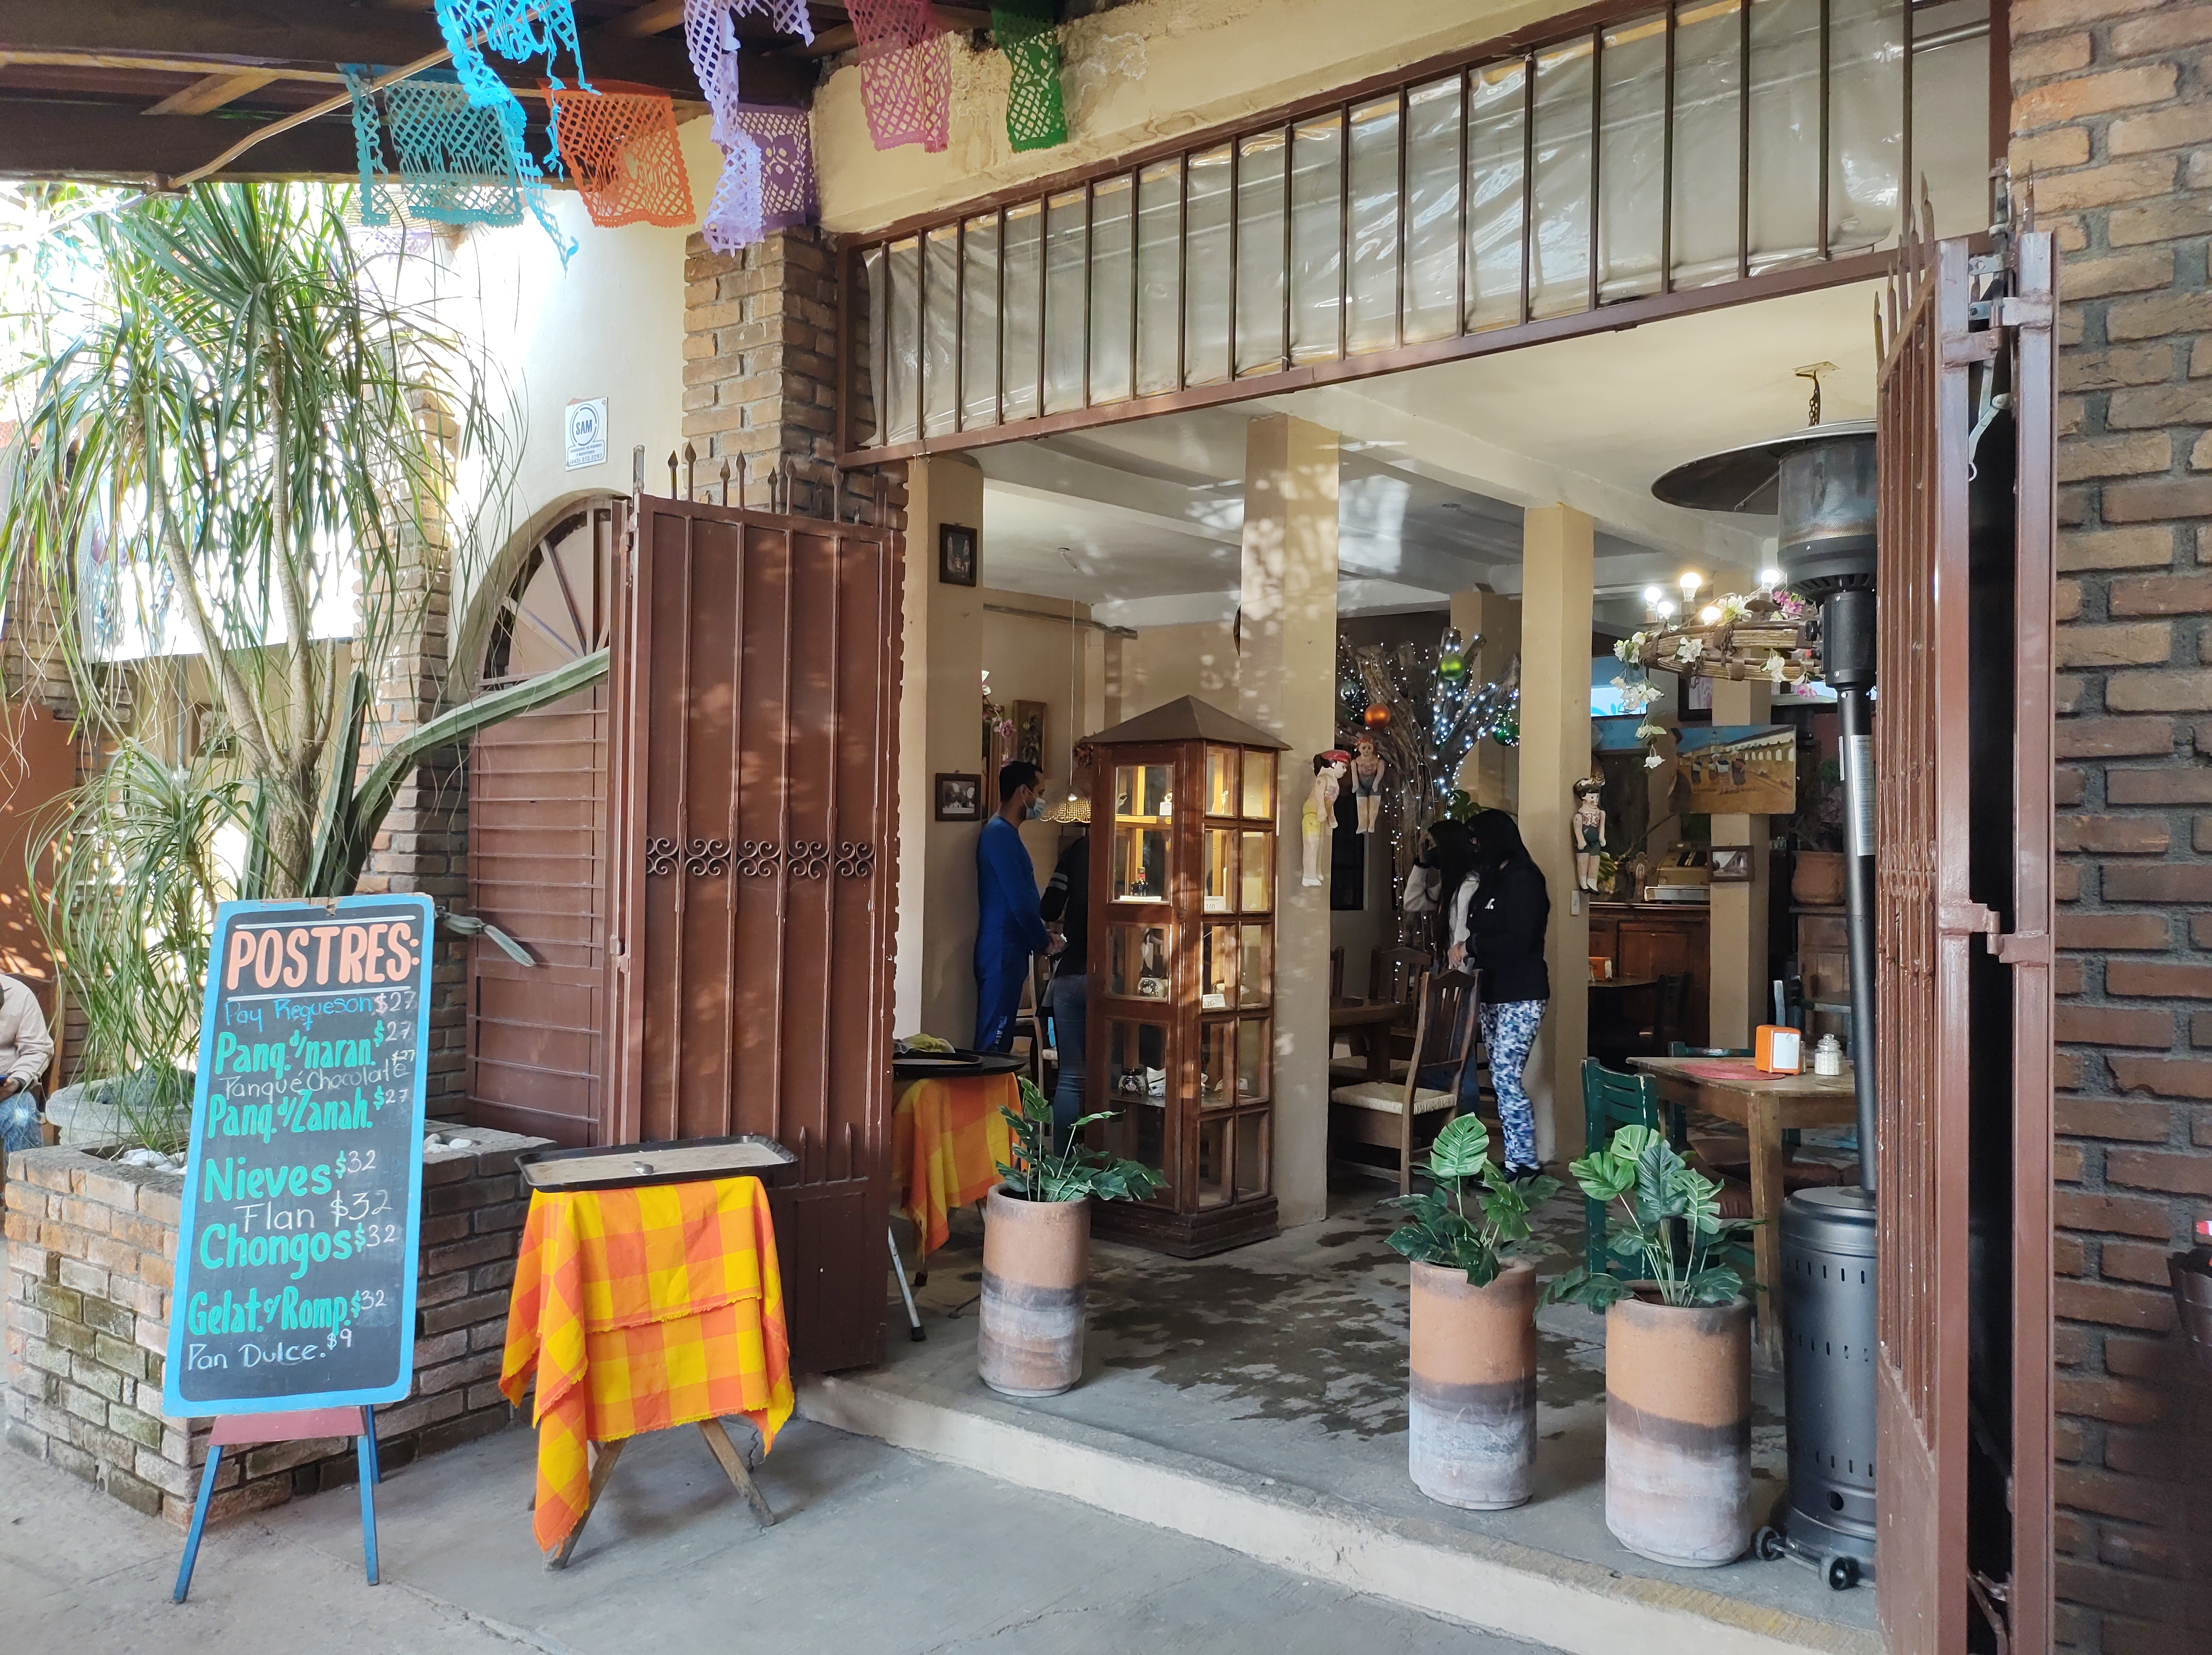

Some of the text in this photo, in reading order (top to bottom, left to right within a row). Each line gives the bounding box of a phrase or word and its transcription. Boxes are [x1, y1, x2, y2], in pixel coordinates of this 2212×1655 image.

[576, 419, 593, 436] SAM
[226, 922, 420, 990] POSTRES:
[225, 1001, 263, 1033] Pay
[373, 991, 417, 1015] $27
[373, 1020, 412, 1048] $27
[218, 1049, 416, 1104] Panqué Chocolate $27
[373, 1085, 409, 1111] $27
[204, 1149, 377, 1203] Nieves $32
[234, 1189, 393, 1233] Flan $32
[200, 1222, 397, 1280] Chongos $32
[188, 1287, 264, 1336] Gelat.
[351, 1289, 387, 1318] $32
[188, 1343, 228, 1371] Pan
[327, 1328, 352, 1350] $9
